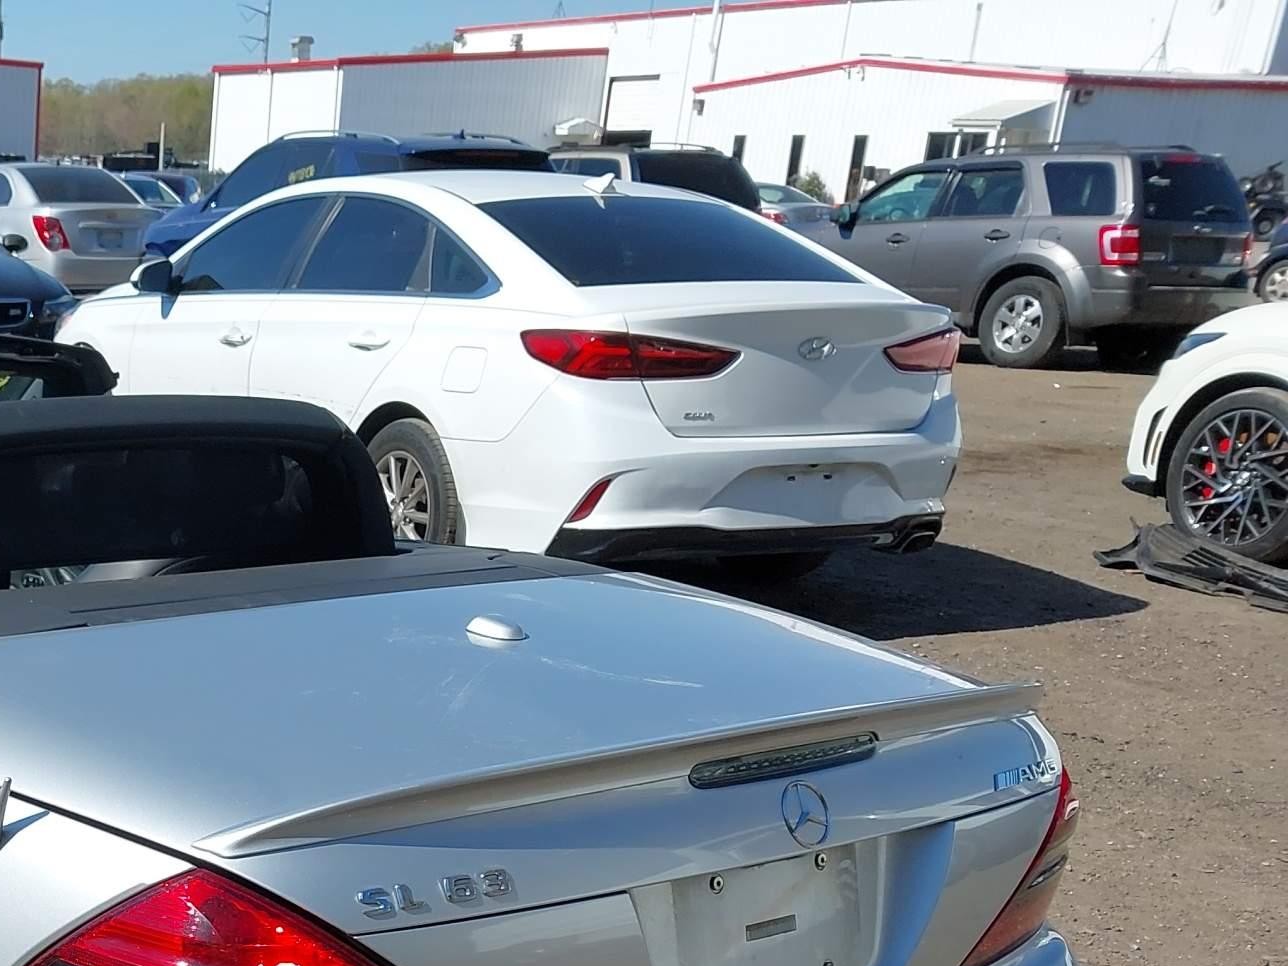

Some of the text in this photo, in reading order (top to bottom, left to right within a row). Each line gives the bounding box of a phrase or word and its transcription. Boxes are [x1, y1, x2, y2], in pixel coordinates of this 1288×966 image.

[1018, 759, 1057, 783] AMG
[356, 868, 515, 920] SL 63
